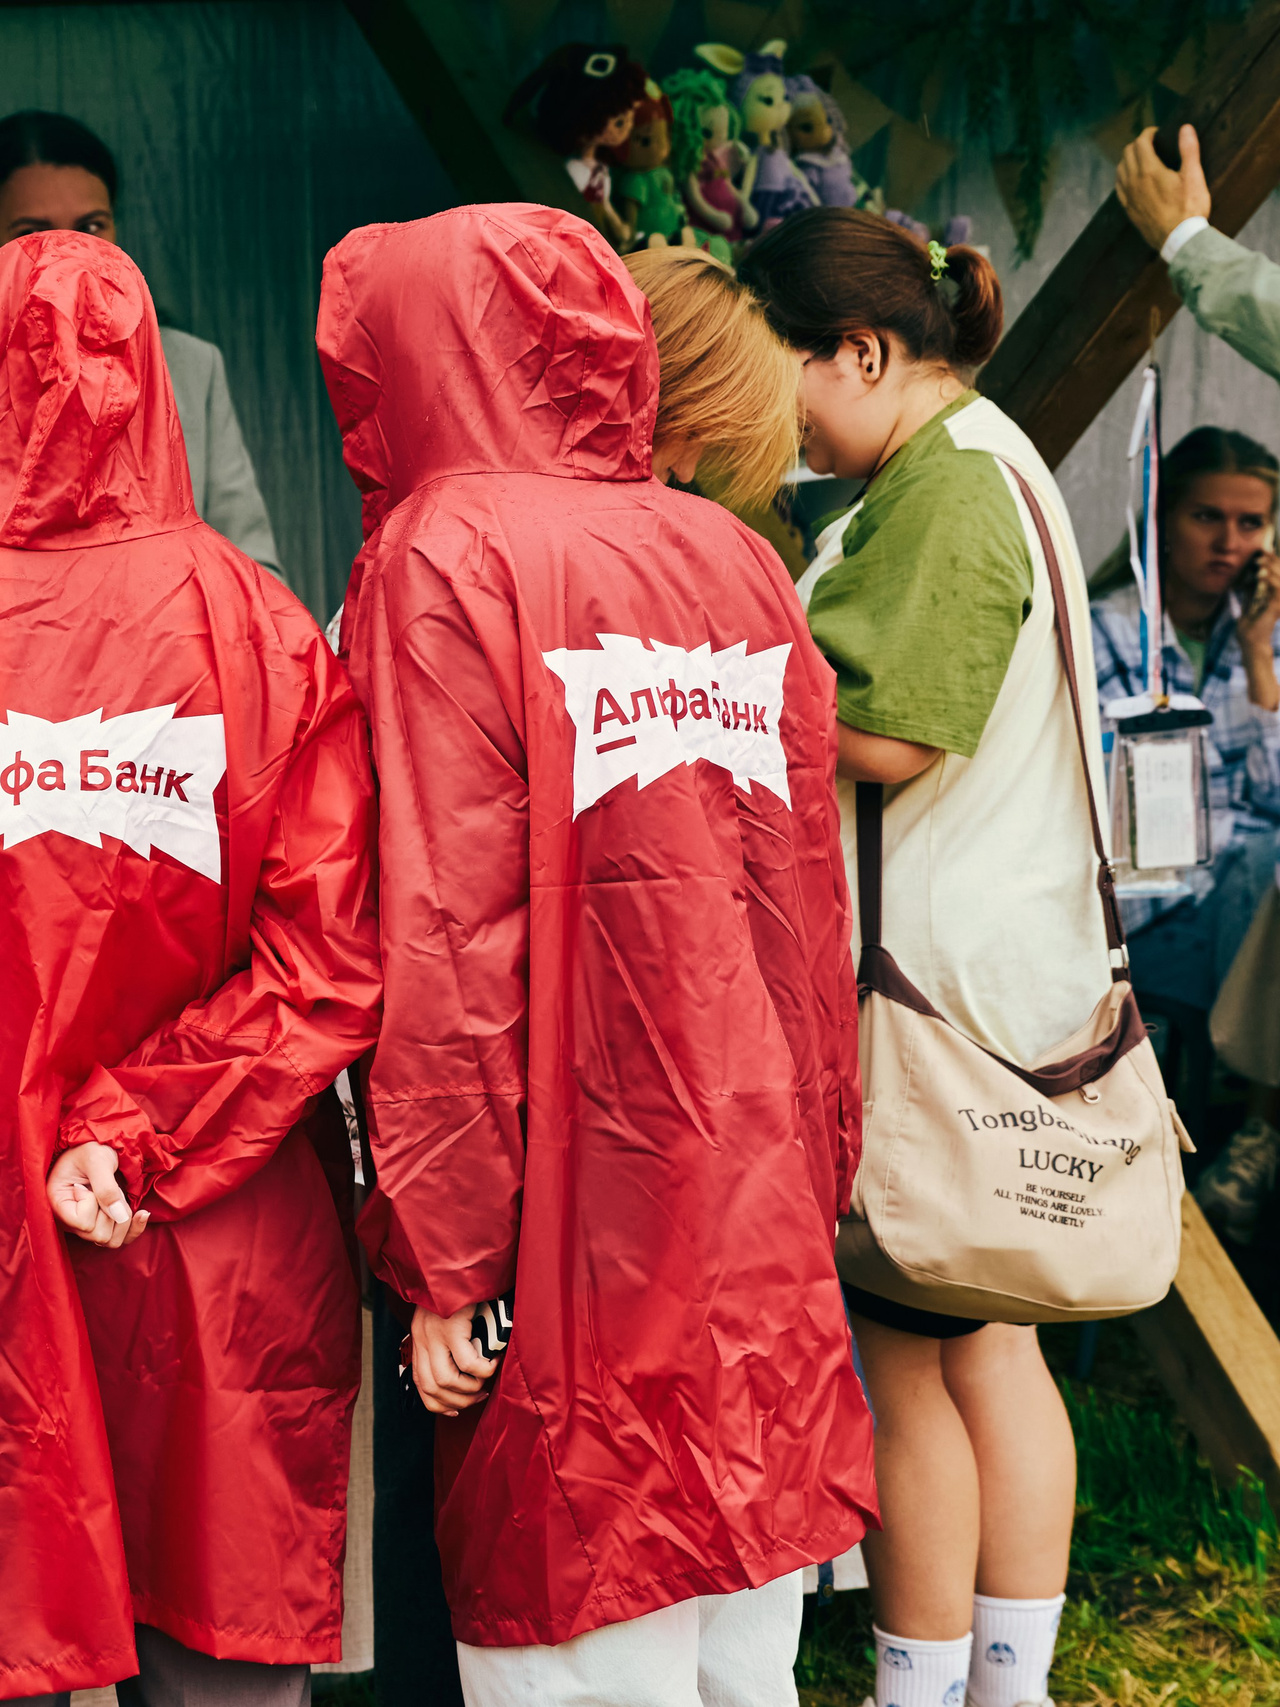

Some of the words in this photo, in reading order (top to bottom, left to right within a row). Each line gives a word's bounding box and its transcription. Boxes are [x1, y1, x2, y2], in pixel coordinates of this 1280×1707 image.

[80, 750, 194, 803] Банк
[1018, 1148, 1104, 1183] LUCKY
[993, 1188, 1012, 1200] ALL
[1015, 1193, 1048, 1208] THINGS
[1050, 1202, 1068, 1213] ARE
[1025, 1183, 1037, 1193] BE
[1020, 1207, 1046, 1220] WALK
[1048, 1214, 1085, 1228] QUIETLY
